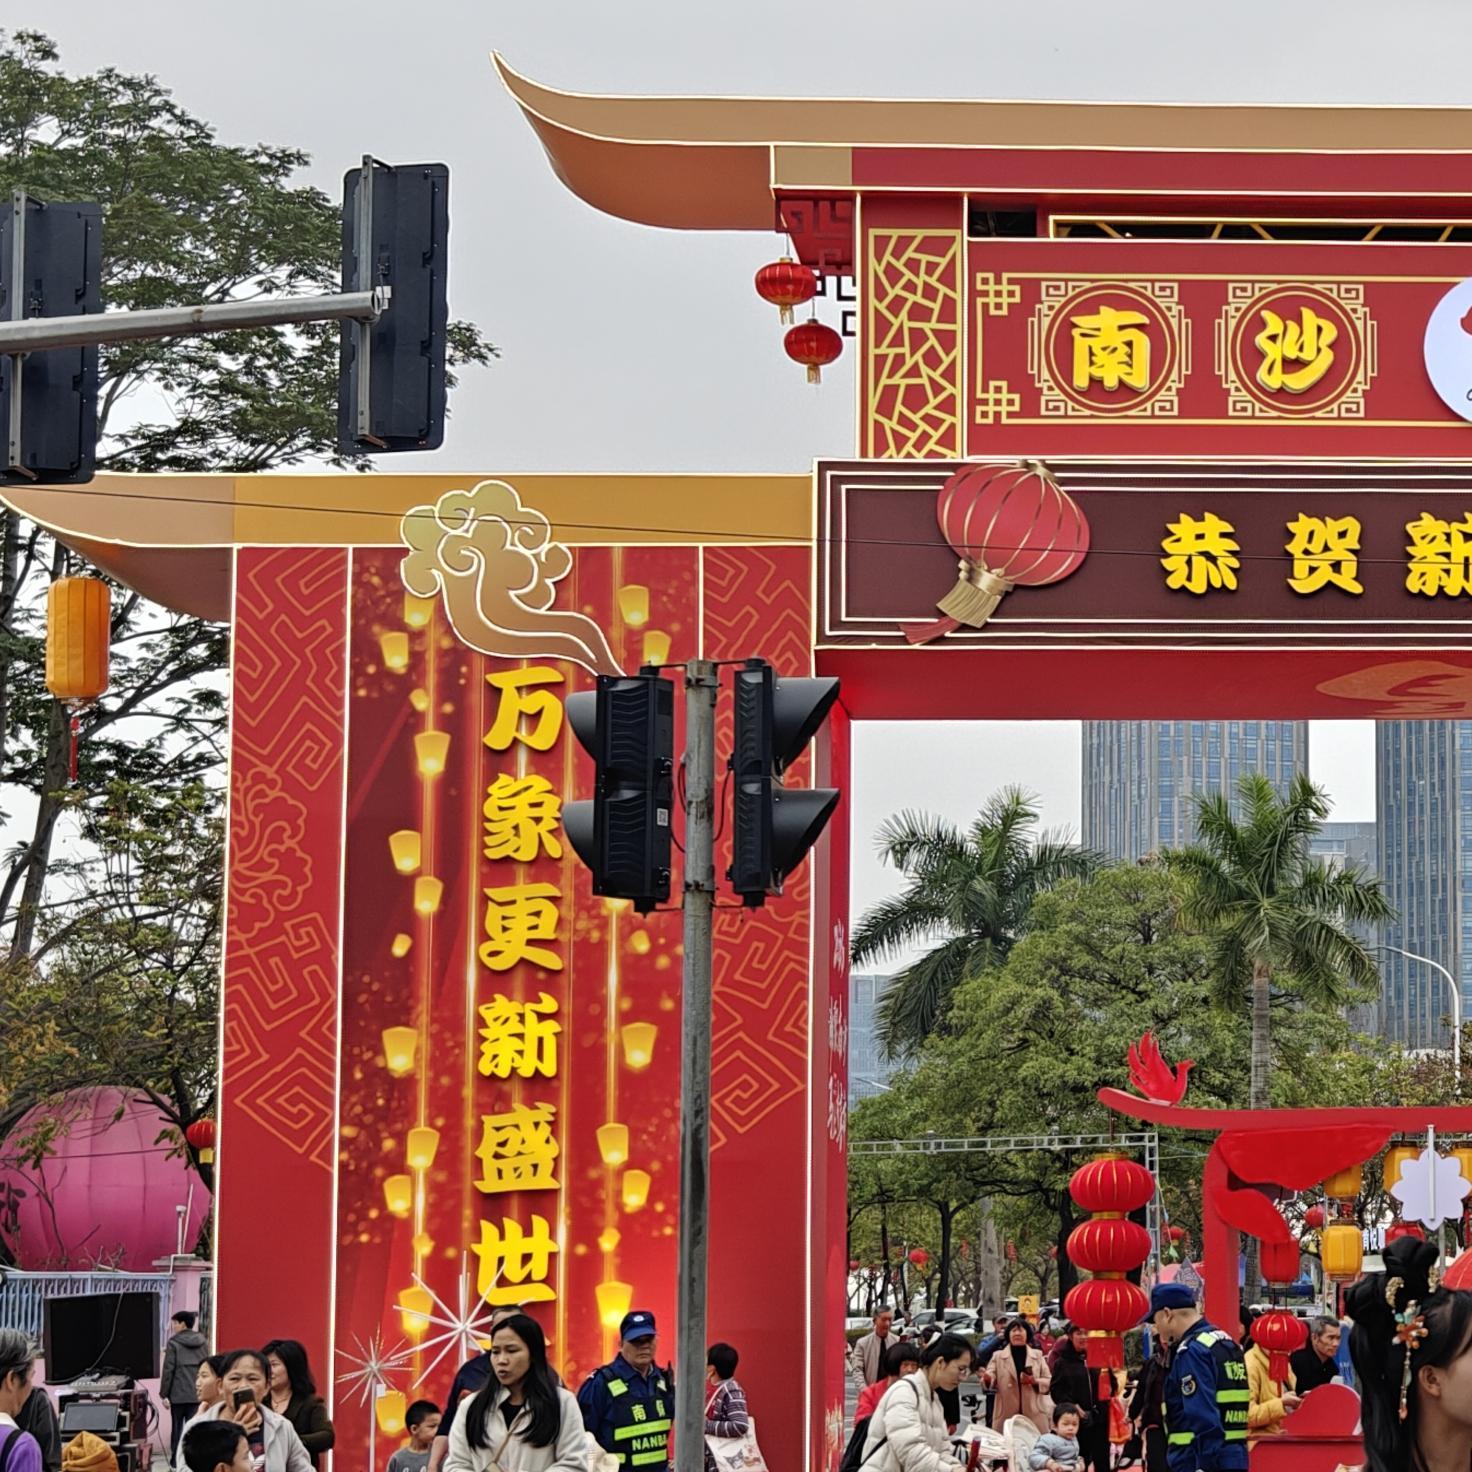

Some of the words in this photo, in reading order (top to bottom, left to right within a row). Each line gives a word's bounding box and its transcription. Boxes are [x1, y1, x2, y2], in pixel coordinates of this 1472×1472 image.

[1072, 306, 1337, 390] 南沙
[471, 666, 564, 1350] 万象更新盛世
